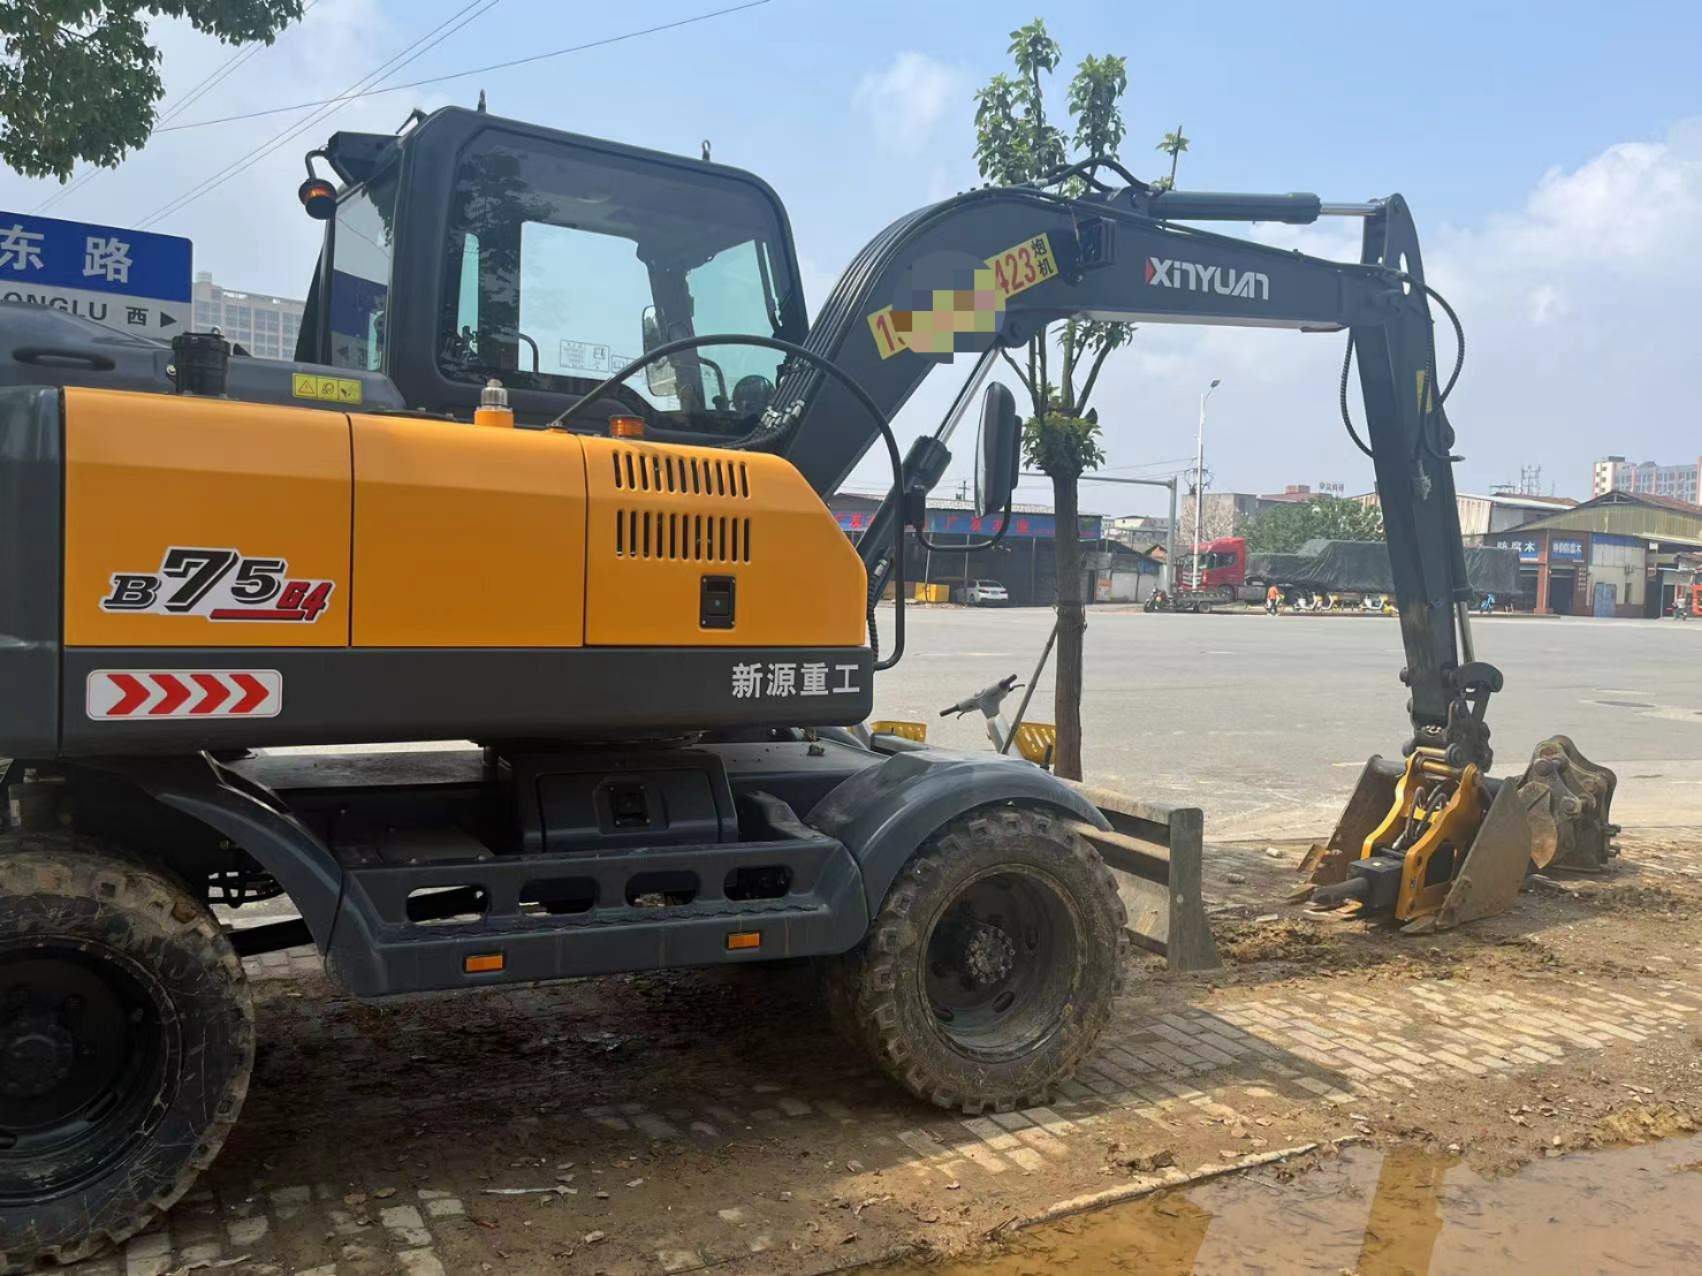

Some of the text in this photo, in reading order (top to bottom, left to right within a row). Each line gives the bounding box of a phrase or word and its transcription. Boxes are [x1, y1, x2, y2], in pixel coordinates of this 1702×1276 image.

[0, 224, 133, 284] 东路
[732, 662, 860, 698] 新源重工
